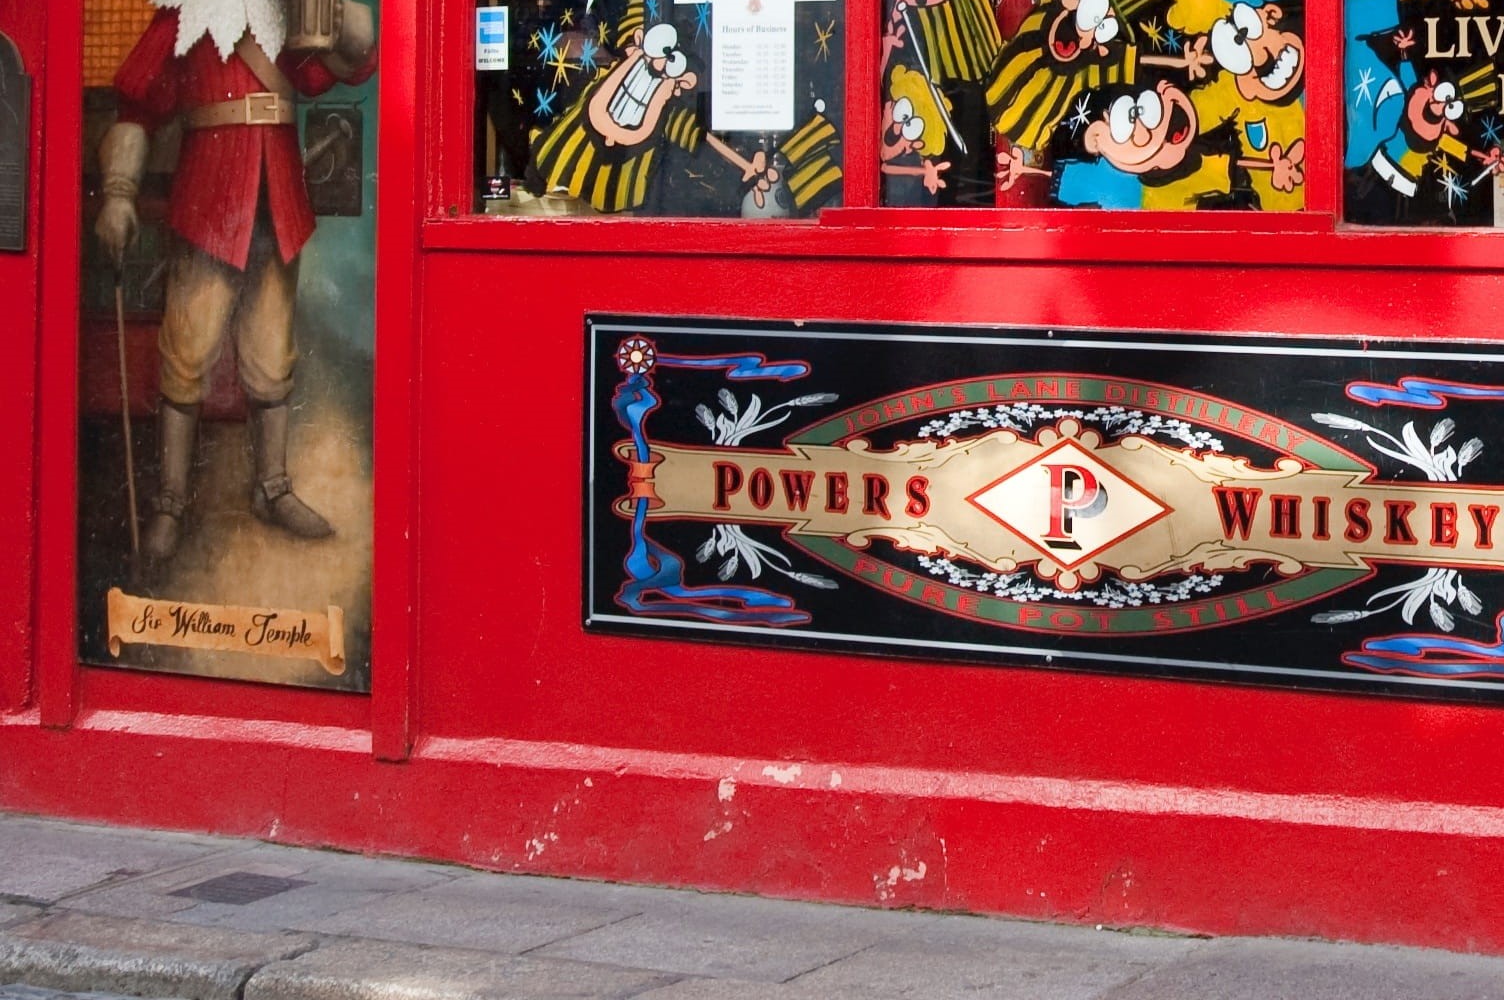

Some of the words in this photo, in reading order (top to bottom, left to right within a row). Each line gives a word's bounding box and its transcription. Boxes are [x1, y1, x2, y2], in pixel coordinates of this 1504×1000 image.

[843, 385, 969, 435] JOHN'S
[986, 378, 1082, 401] LANE
[1103, 382, 1308, 452] DISTILLERY
[711, 459, 932, 522] POWERS
[1211, 485, 1501, 550] WHISKEY
[131, 604, 163, 635] Sir
[169, 604, 237, 639] William
[244, 612, 315, 649] Temple
[852, 557, 981, 615] PURE
[1016, 606, 1120, 631] POT
[1151, 590, 1296, 632] STILL
